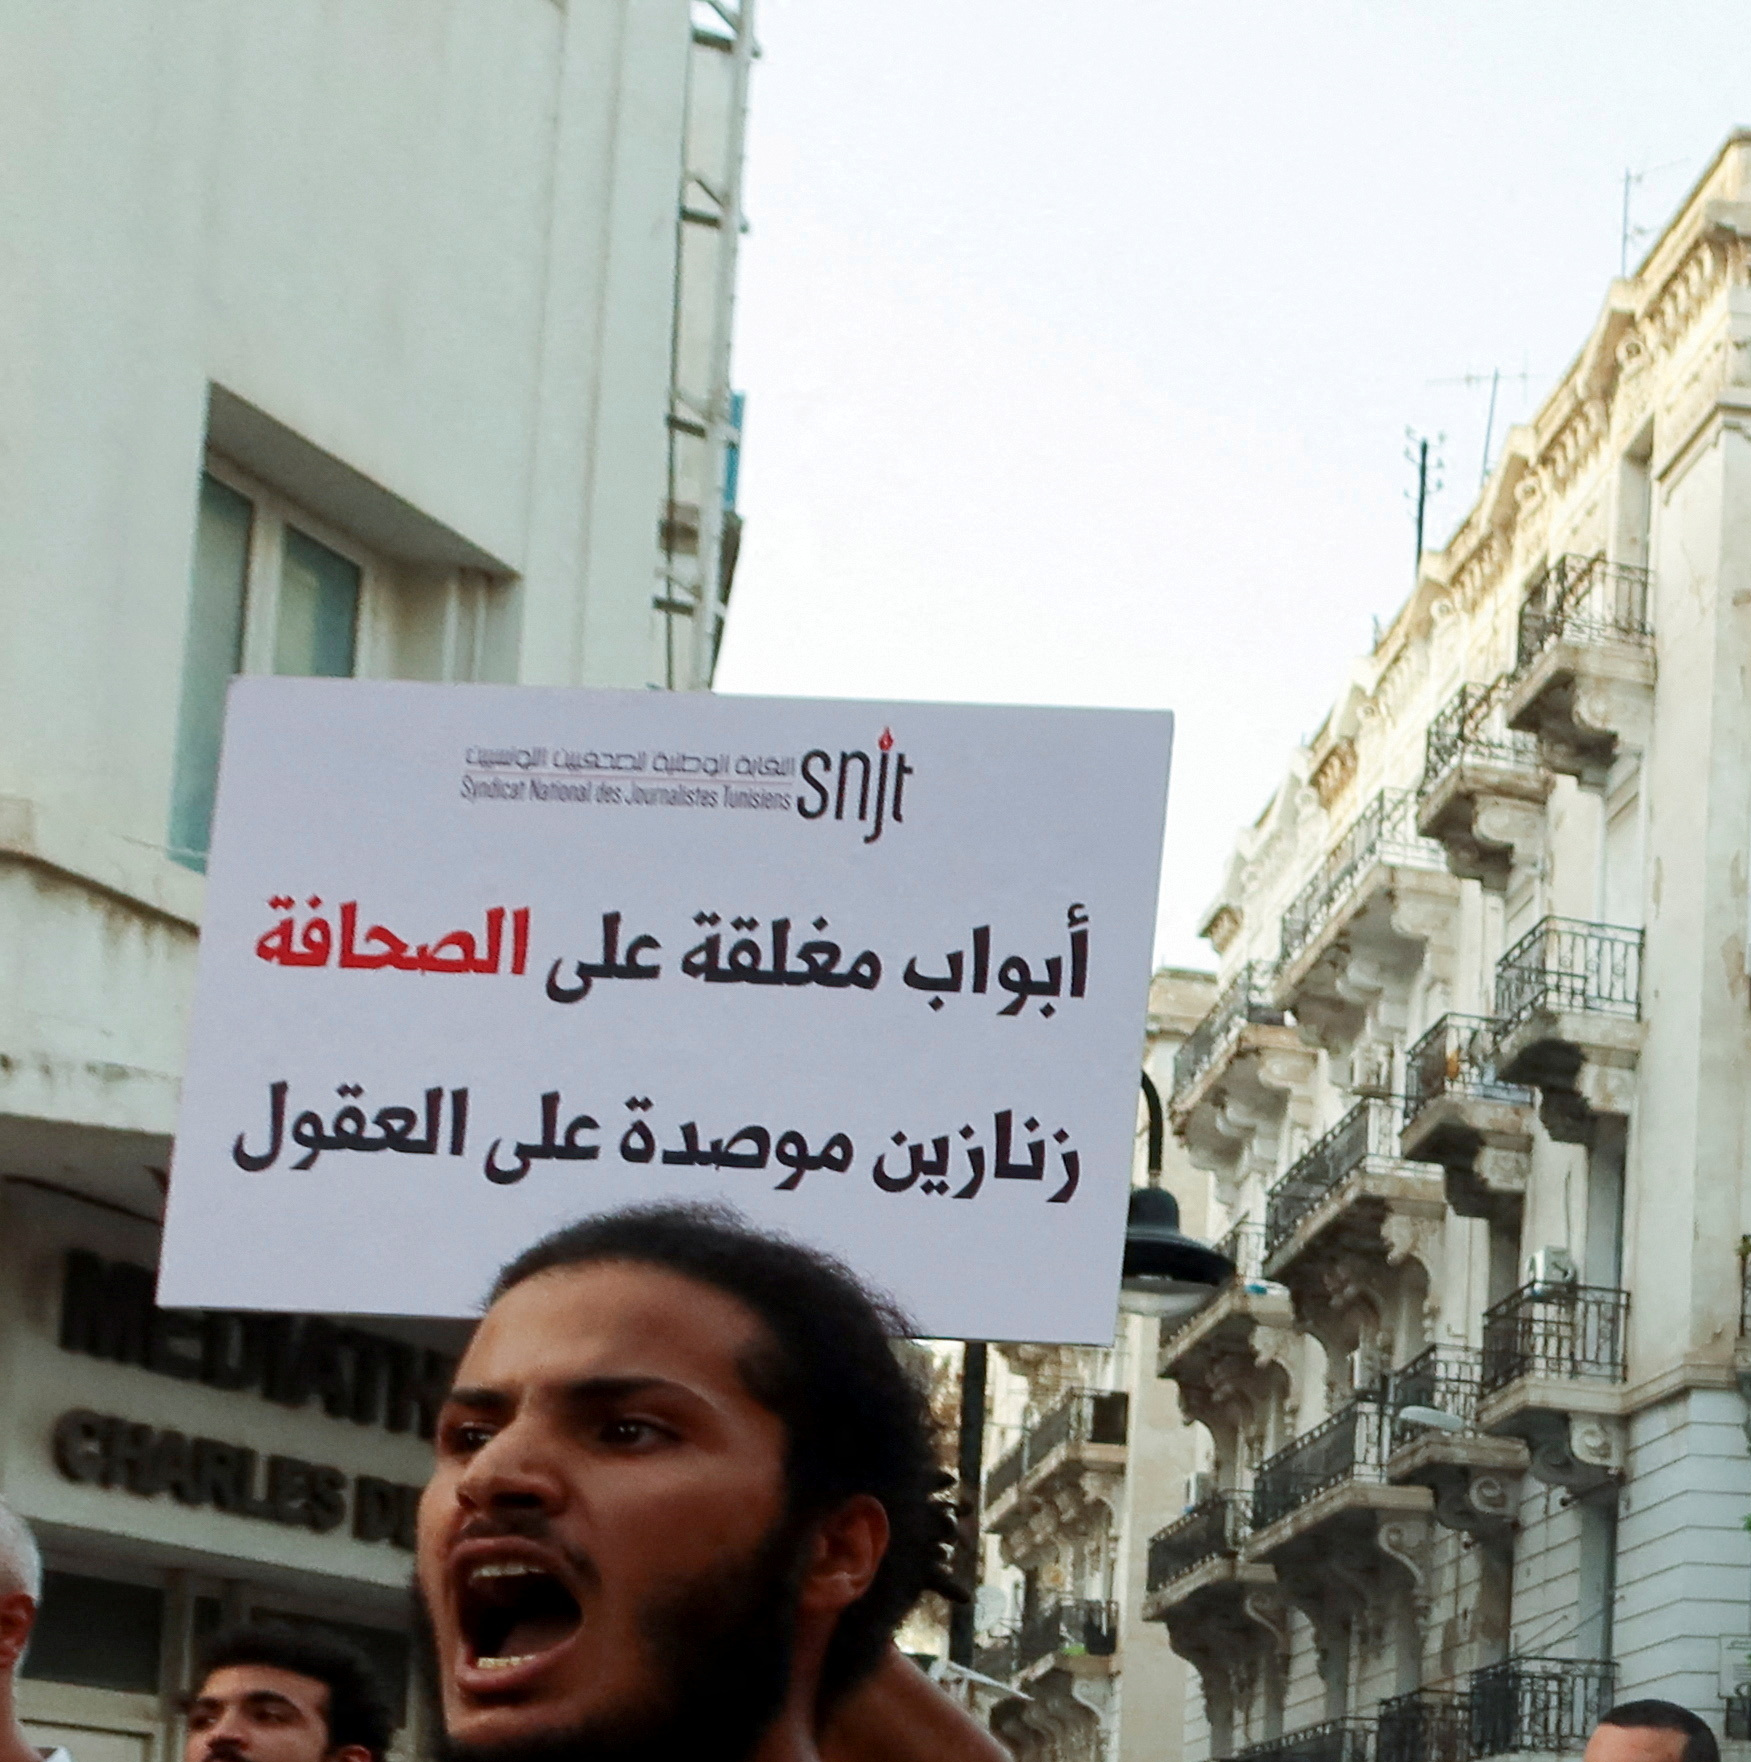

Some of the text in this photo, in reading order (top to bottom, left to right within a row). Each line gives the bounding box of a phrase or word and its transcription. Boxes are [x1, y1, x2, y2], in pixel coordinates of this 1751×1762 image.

[528, 779, 593, 802] National
[595, 782, 622, 804] des
[796, 725, 914, 845] snjt
[254, 894, 1089, 1017] أبواب مغلقة على الصحافة
[232, 1080, 1081, 1205] زنازين موصدة على العقول
[52, 1407, 348, 1535] CHARLES
